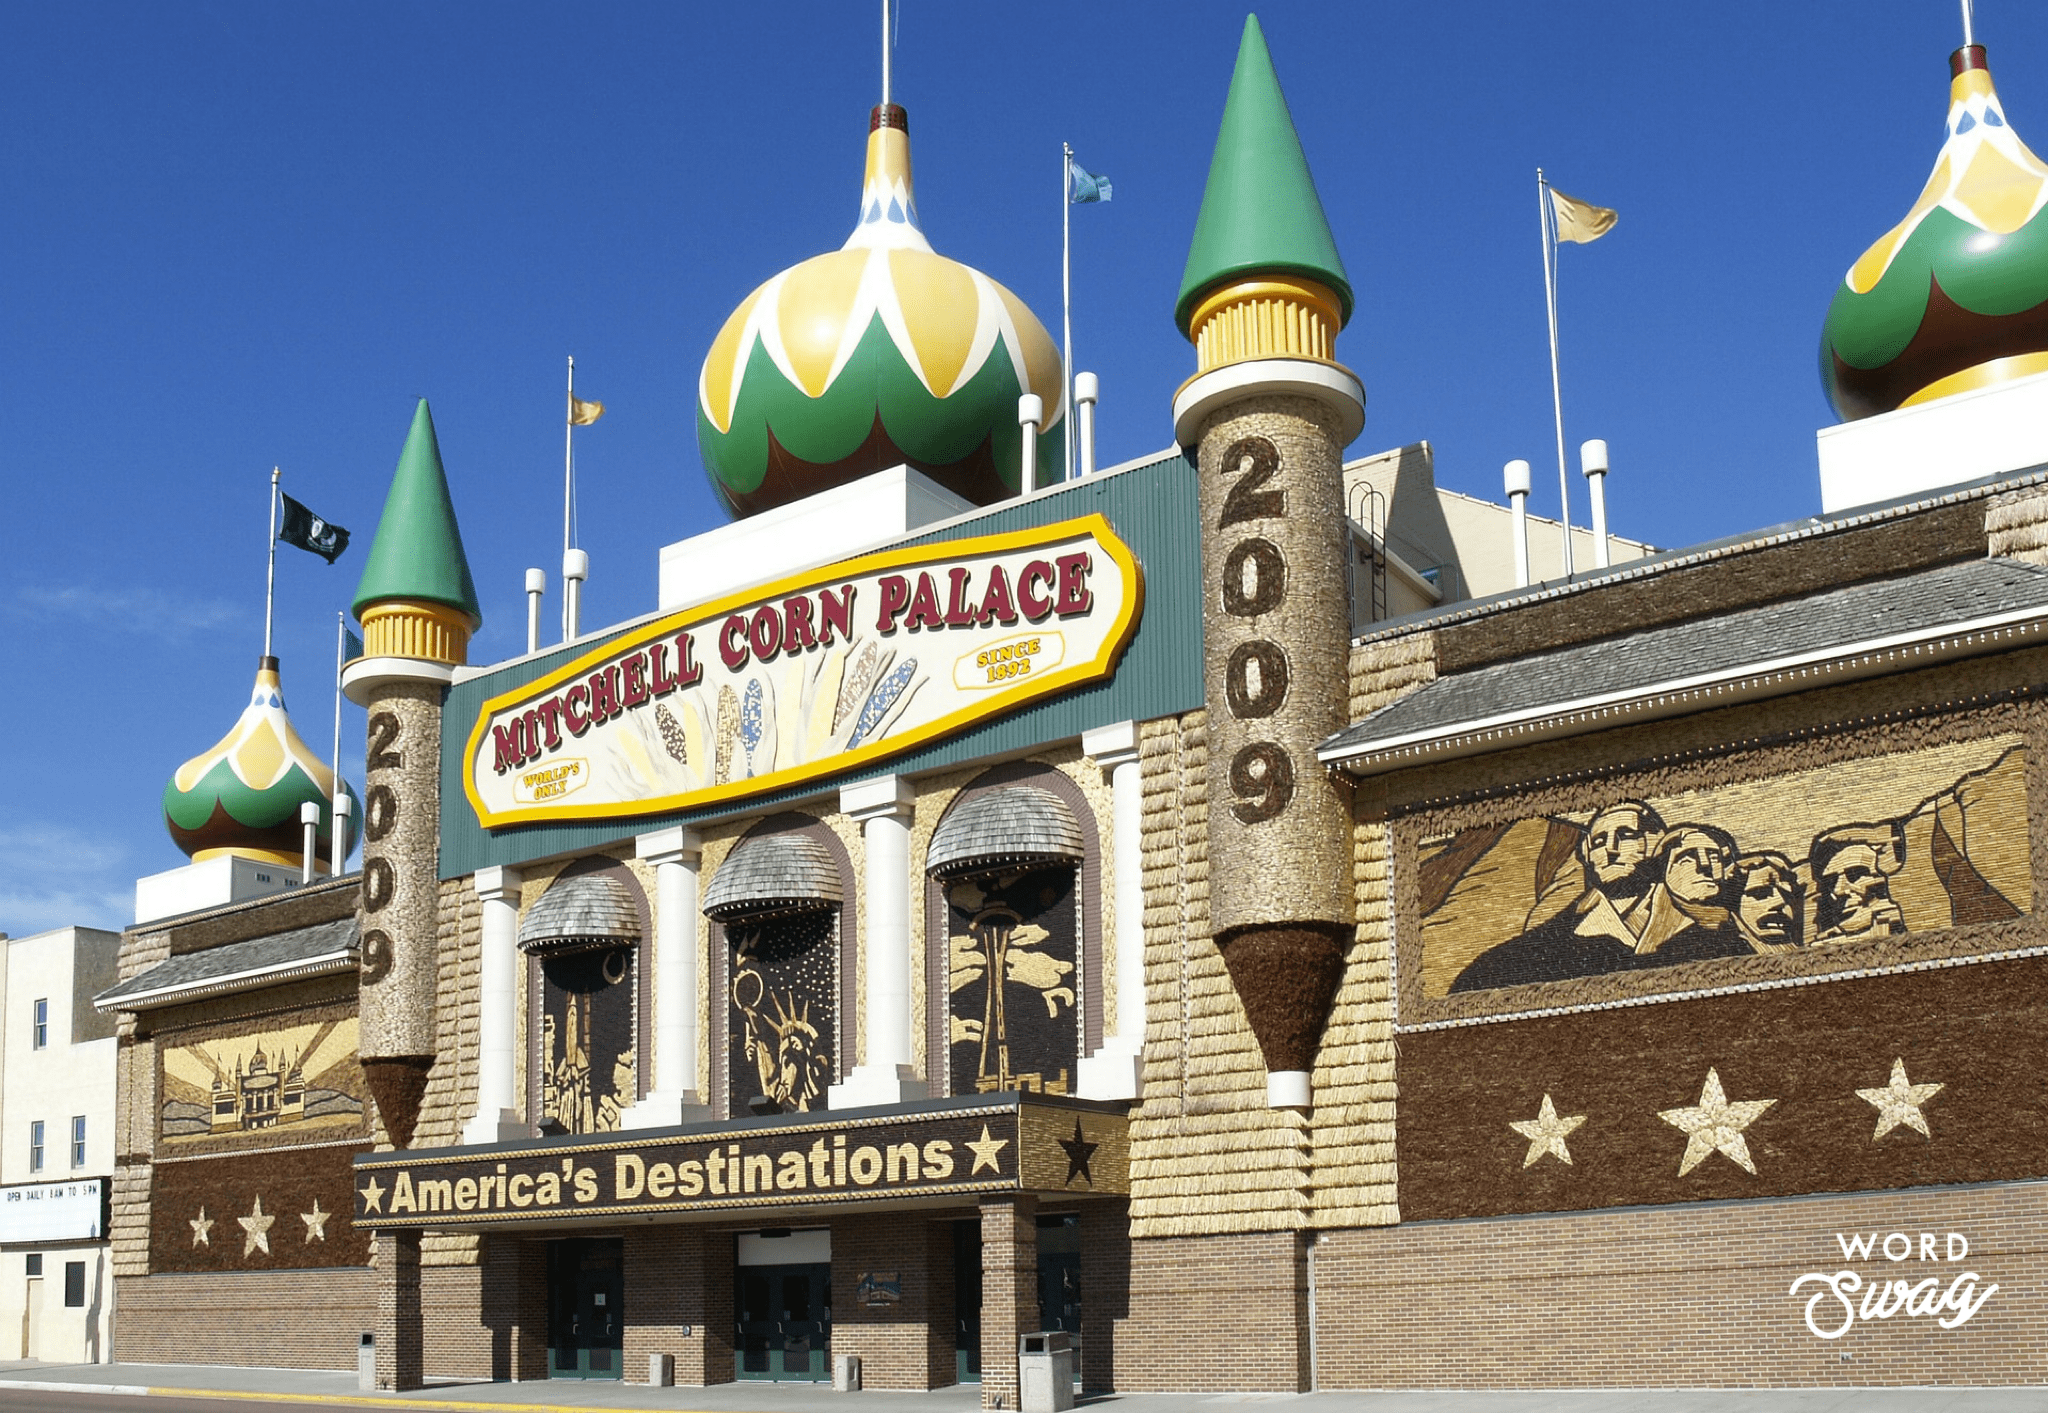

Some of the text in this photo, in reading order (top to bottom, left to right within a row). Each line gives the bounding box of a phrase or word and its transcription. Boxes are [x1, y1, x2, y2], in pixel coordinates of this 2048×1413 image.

[1219, 435, 1295, 825] 2009
[493, 551, 1094, 776] MITCHELL CORN PALACE
[976, 638, 1040, 668] SINCE
[986, 658, 1030, 683] 1892
[523, 762, 580, 788] WORLD'S
[533, 780, 567, 800] ONLY
[360, 711, 404, 987] 2009
[389, 1134, 956, 1214] America's Destinations
[7, 1191, 21, 1202] OPEN
[26, 1189, 44, 1201] DAILY
[68, 1186, 77, 1197] TO
